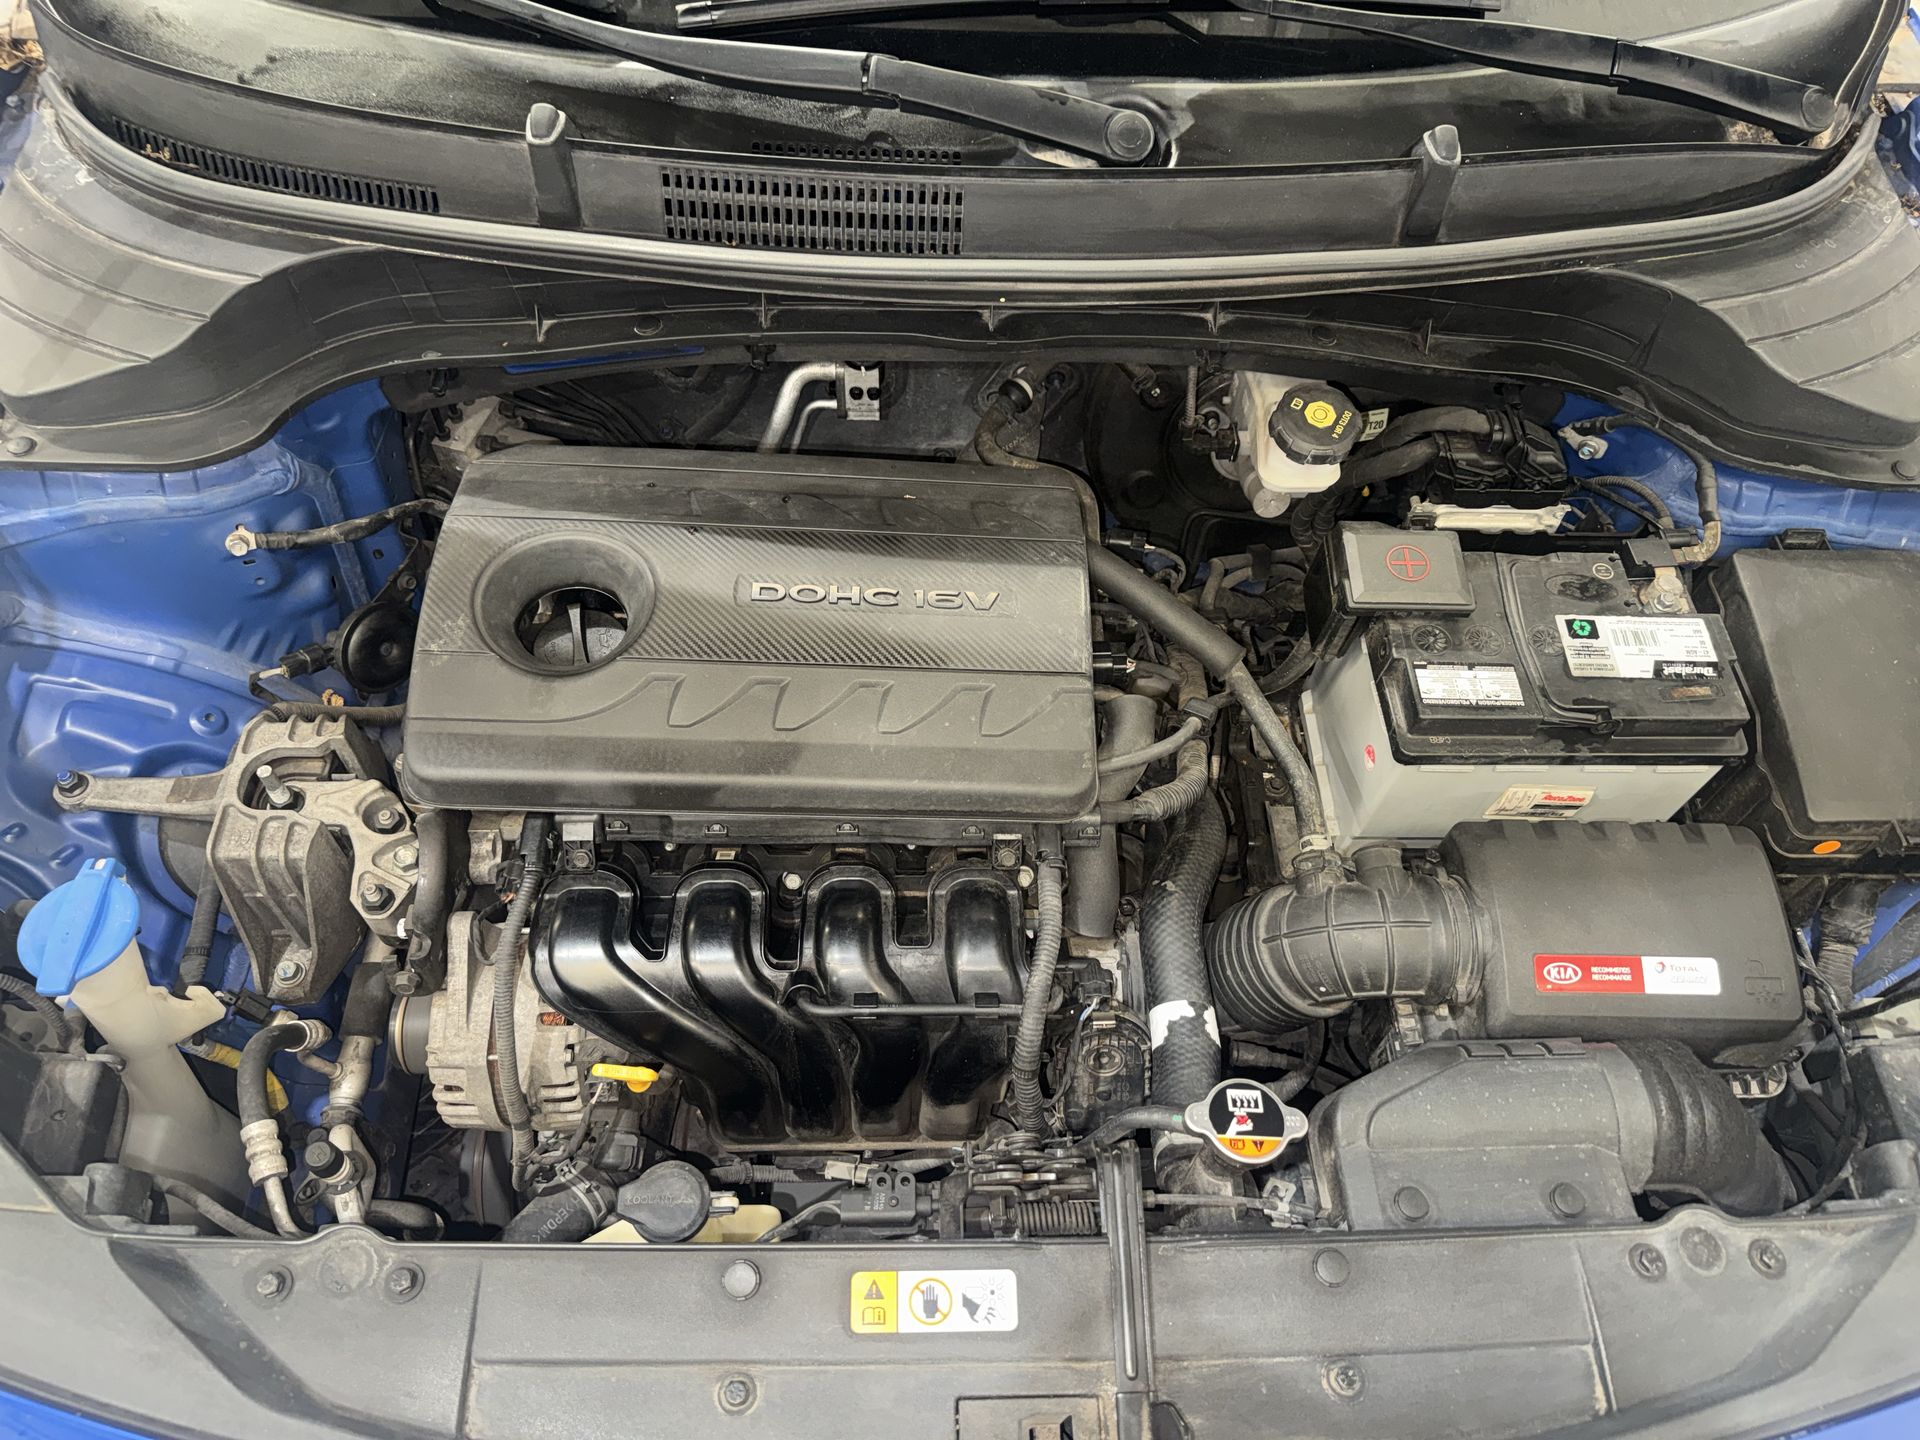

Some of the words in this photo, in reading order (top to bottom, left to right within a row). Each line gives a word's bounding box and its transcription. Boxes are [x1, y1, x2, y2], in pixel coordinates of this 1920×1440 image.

[1339, 410, 1352, 426] DOT3
[1334, 424, 1344, 435] OR
[751, 582, 900, 607] DOHC
[913, 589, 1000, 611] 16V
[1662, 666, 1718, 677] Duralast
[1550, 967, 1576, 980] KIA
[1591, 966, 1631, 974] RECOMMENDS
[1591, 973, 1633, 981] RECOMMANDE
[625, 1194, 673, 1205] COOLANT
